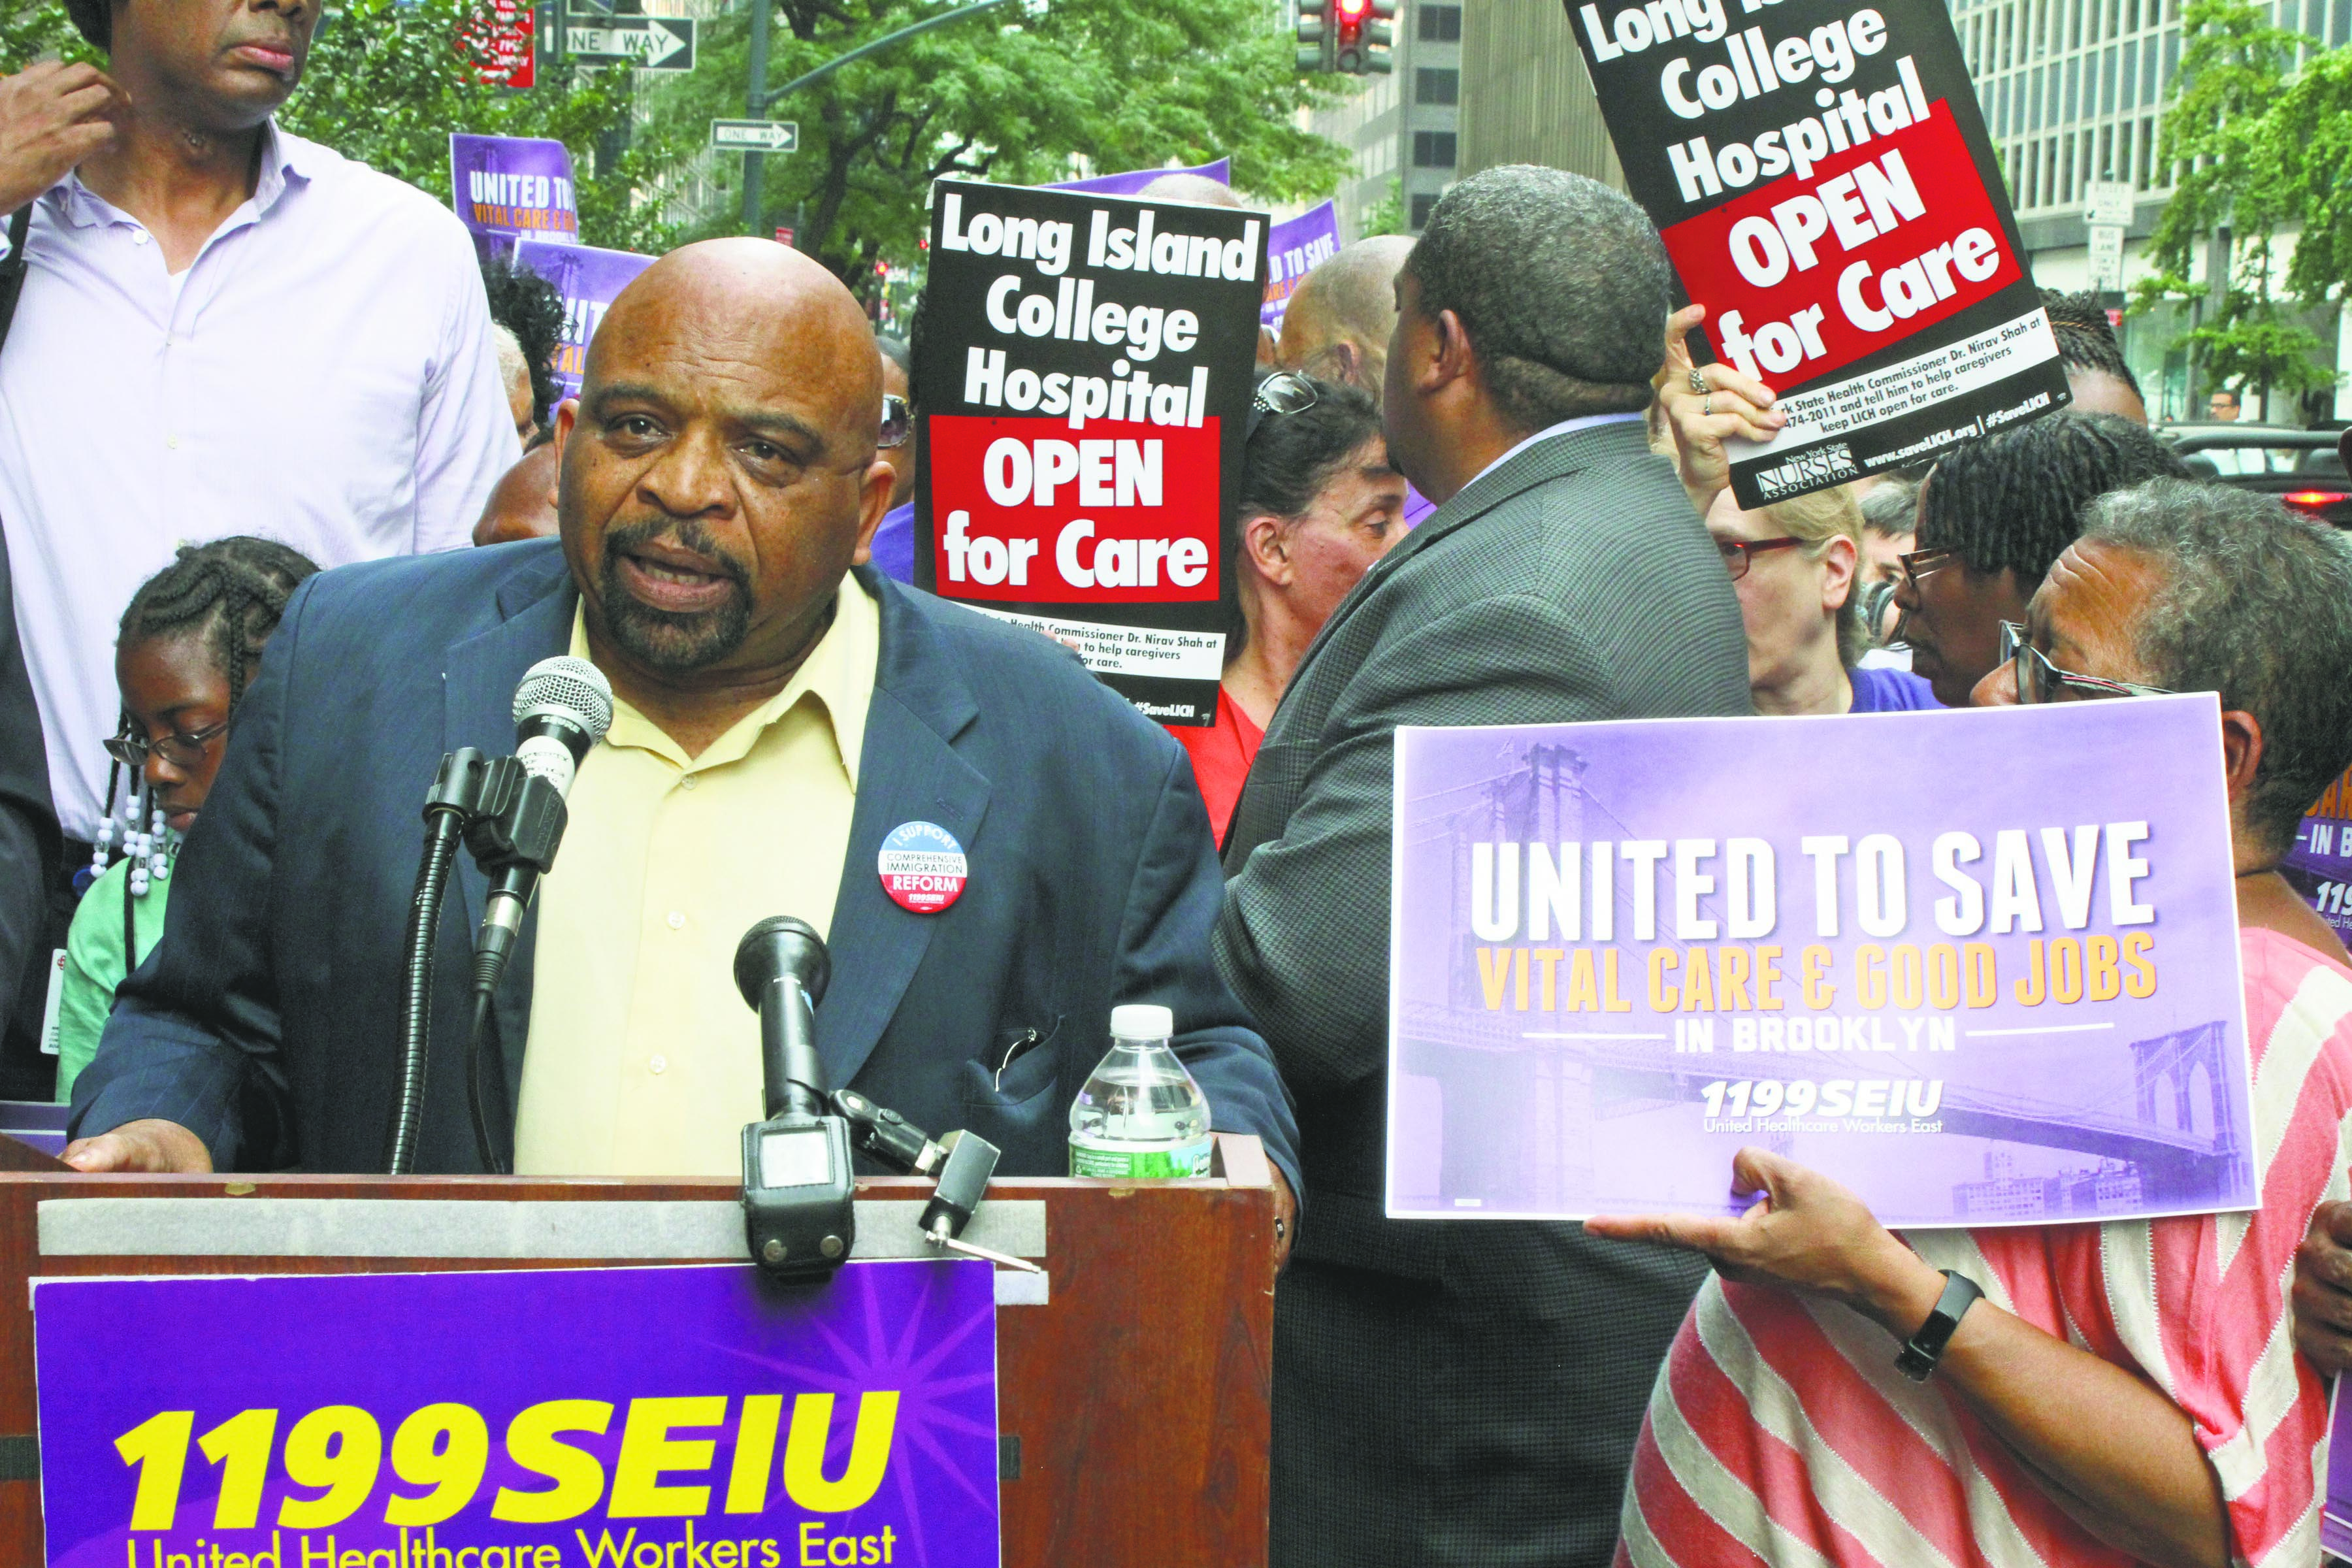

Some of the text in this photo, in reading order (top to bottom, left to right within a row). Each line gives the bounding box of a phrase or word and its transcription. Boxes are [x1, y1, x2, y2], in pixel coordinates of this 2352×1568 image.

[572, 31, 668, 52] NE WAY
[1579, 0, 1728, 63] Long
[1661, 8, 1887, 118] College
[1667, 55, 1931, 203] Hospital
[470, 171, 549, 208] UNITED
[474, 203, 510, 225] VITAL
[513, 207, 549, 230] CARE
[941, 193, 1260, 282] Long Island
[1729, 148, 1926, 287] OPEN
[1284, 247, 1305, 277] TO
[1305, 232, 1335, 270] SAVE
[1266, 279, 1285, 302] ARE
[1718, 227, 2000, 382] for Care
[987, 275, 1198, 361] College
[1795, 396, 1825, 412] State
[1827, 383, 1865, 402] Health
[1868, 355, 1947, 388] Commissioner
[1950, 350, 1966, 362] Dr.
[1968, 337, 1999, 355] Nirav
[2001, 325, 2028, 342] Shah
[2030, 317, 2041, 331] at
[1840, 397, 1861, 413] and
[1865, 389, 1884, 405] tell
[1887, 382, 1909, 399] him
[1912, 378, 1923, 390] to
[1926, 368, 1952, 387] help
[1955, 346, 2012, 374] caregivers
[964, 347, 1208, 429] Hospital
[1820, 384, 1958, 434] keep LICH open for care.
[1864, 392, 2050, 468] www.saveLICH.org #SaveLICH
[983, 437, 1162, 507] OPEN
[1756, 449, 1853, 492] NURSES
[1785, 442, 1848, 465] New York State
[1763, 465, 1859, 500] ASSOCIATION
[943, 510, 1208, 588] for Care
[1085, 642, 1094, 652] to
[1099, 643, 1122, 657] help
[1126, 647, 1181, 661] caregivers
[1097, 657, 1122, 669] care.
[1128, 632, 1141, 644] Dr.
[1145, 634, 1173, 646] Nirav
[1178, 636, 1202, 648] Shah
[1206, 639, 1217, 649] at
[887, 854, 962, 864] COMPREHENSIVE
[892, 825, 957, 849] I SUPPORT
[2310, 824, 2333, 855] IN
[887, 863, 962, 874] IMMIGRATION
[893, 875, 958, 892] REFORM
[1471, 821, 2156, 941] UNITED TO SAVE
[1477, 932, 2157, 1013] VITAL CARE & GOOD JOBS
[1676, 1017, 1955, 1053] IN BROOKLYN
[1701, 1080, 1943, 1117] 1199SEIU
[1704, 1117, 1943, 1134] United Healthcare Workers East
[114, 1391, 900, 1531] 1199SEIU
[128, 1530, 281, 1568] United
[575, 1520, 780, 1568] Workers
[799, 1522, 897, 1567] East
